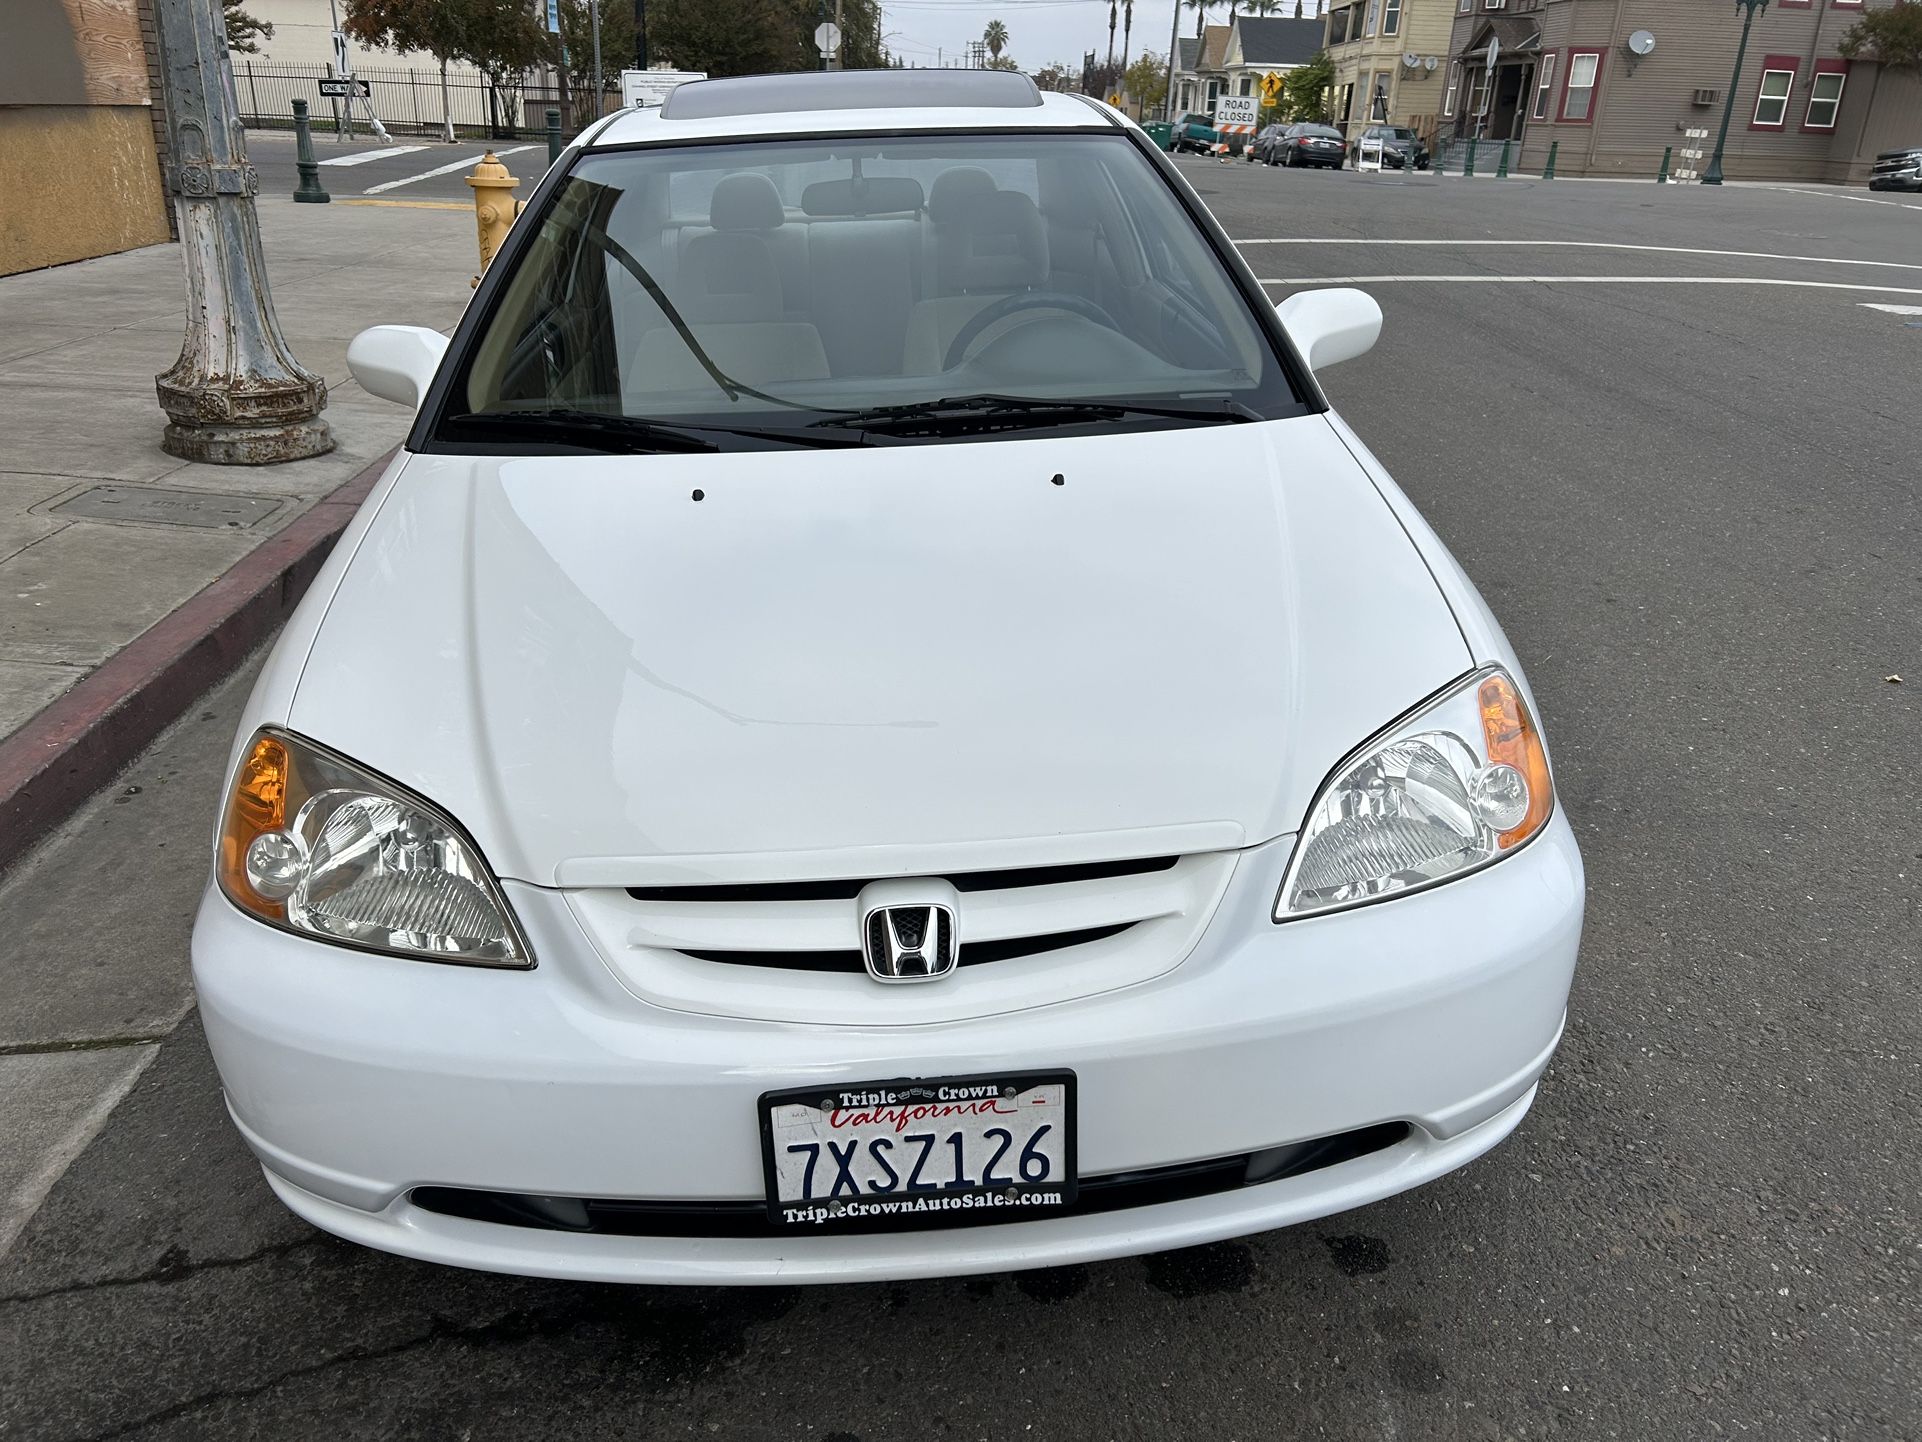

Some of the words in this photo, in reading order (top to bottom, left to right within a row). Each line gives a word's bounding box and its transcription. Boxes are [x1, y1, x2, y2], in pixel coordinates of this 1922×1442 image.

[323, 84, 338, 92] ONE
[1224, 100, 1251, 110] ROAD
[1217, 111, 1254, 122] CLOSED
[839, 1090, 897, 1108] Triple
[938, 1085, 999, 1100] Crown
[830, 1099, 1018, 1132] California
[787, 1124, 1052, 1199] 7XSZ126
